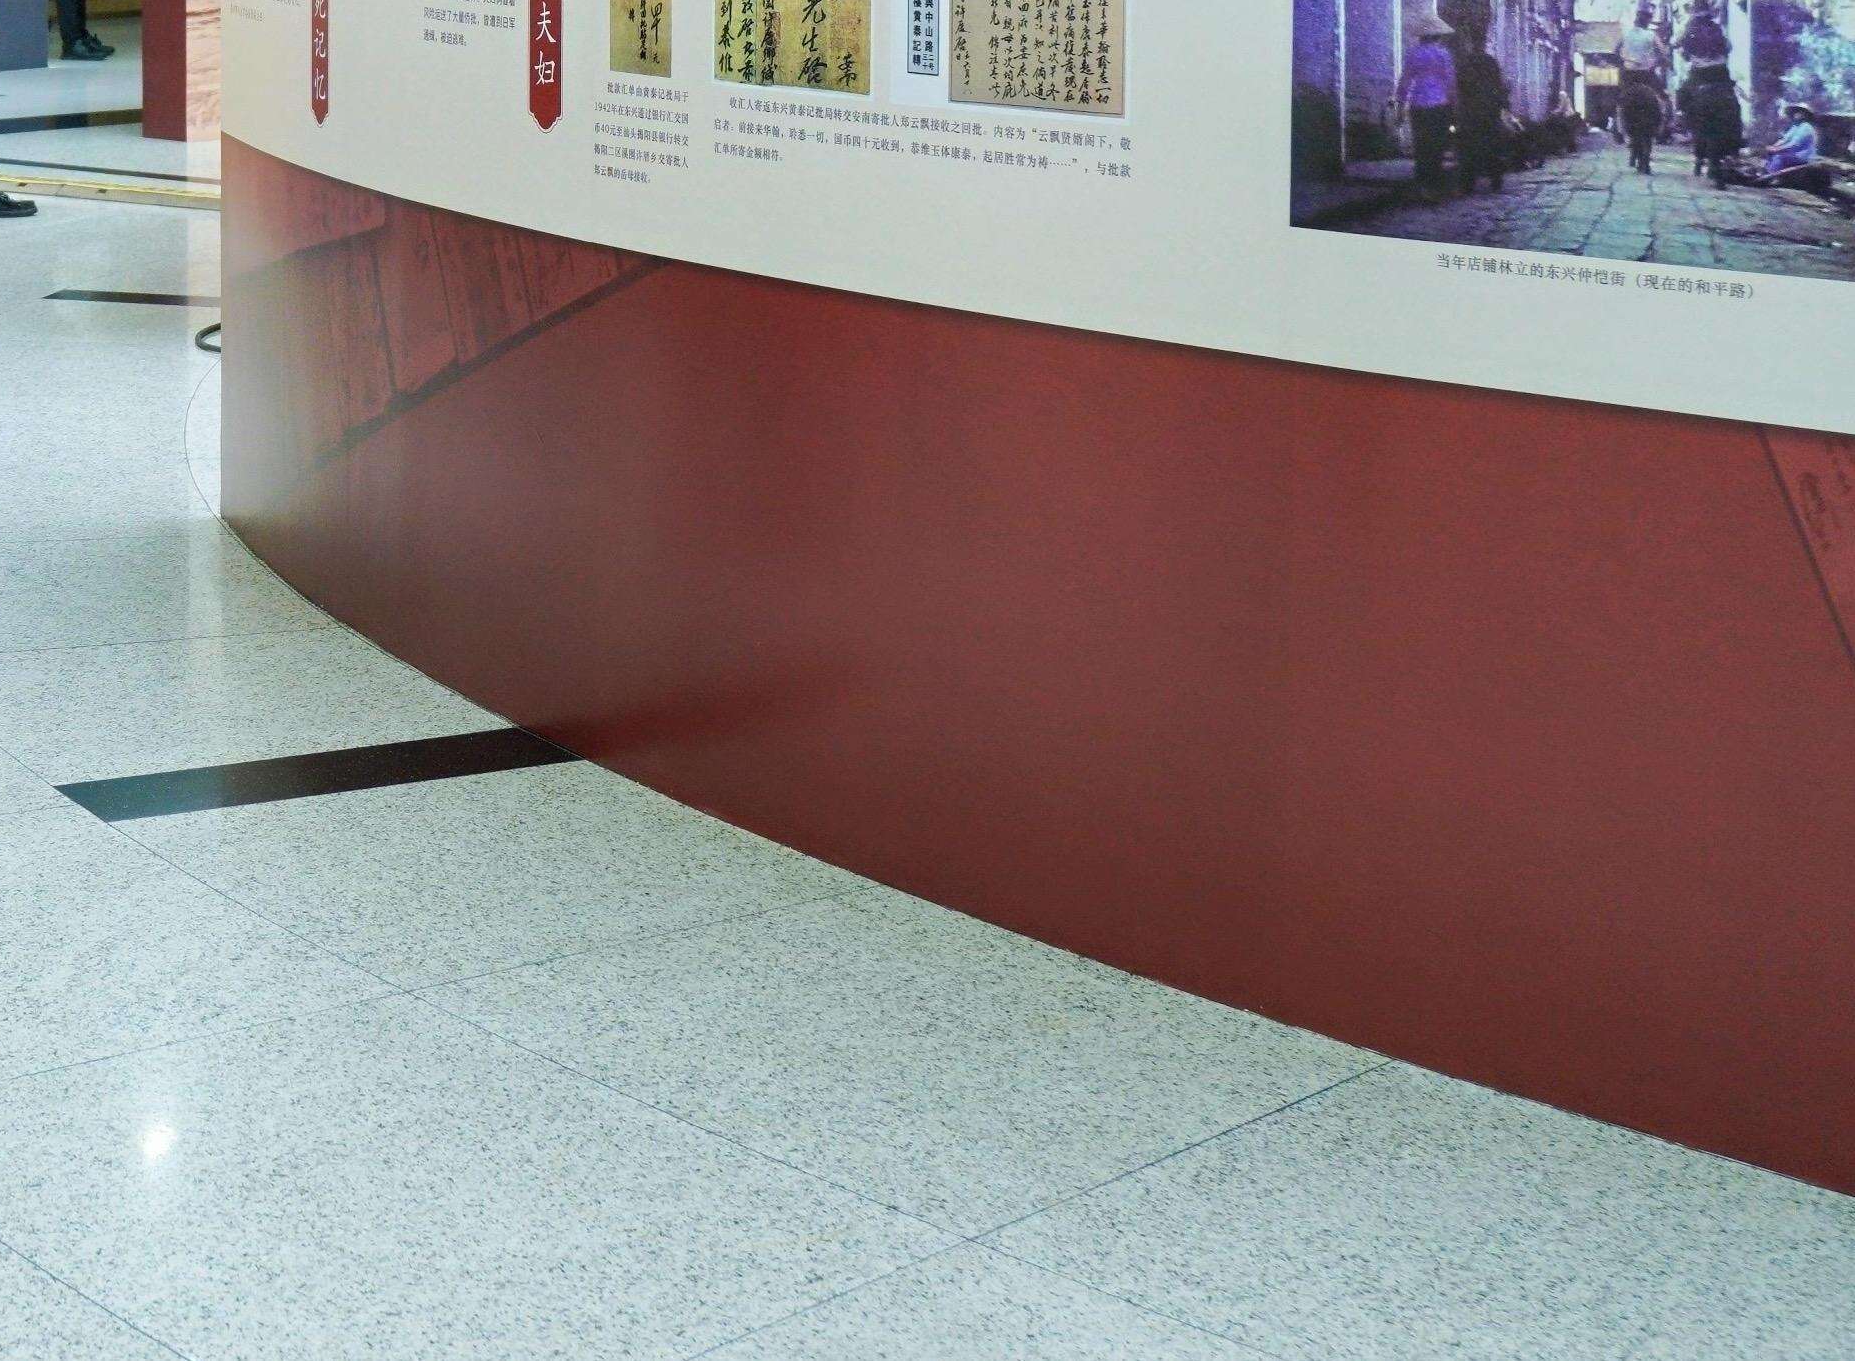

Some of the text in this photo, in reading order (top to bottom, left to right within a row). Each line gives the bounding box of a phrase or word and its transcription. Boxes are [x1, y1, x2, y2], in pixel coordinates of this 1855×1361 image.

[1435, 252, 1754, 300] 当年店铺林立的东兴仲恺街（现在的和平路）
